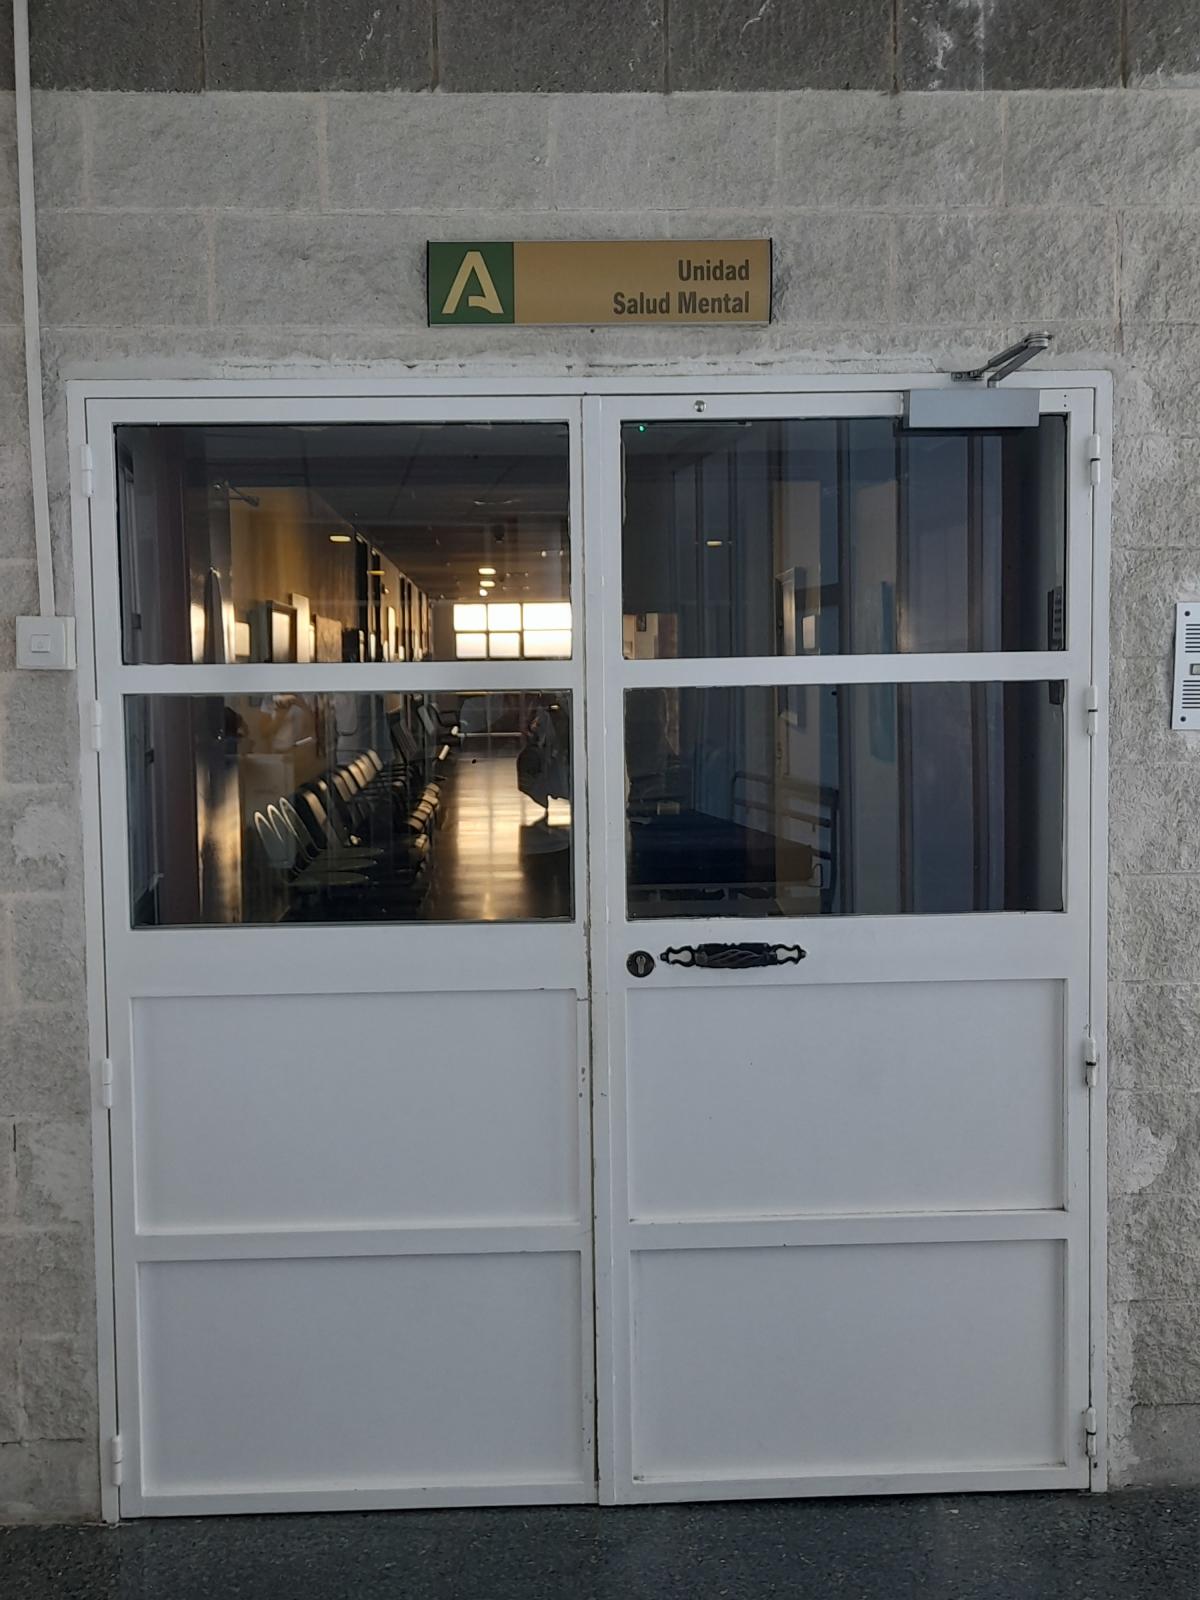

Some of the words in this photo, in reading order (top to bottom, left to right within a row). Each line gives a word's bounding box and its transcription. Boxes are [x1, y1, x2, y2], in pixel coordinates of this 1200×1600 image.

[678, 259, 750, 281] Unidad
[613, 291, 670, 315] Salud
[677, 291, 750, 314] Mental
